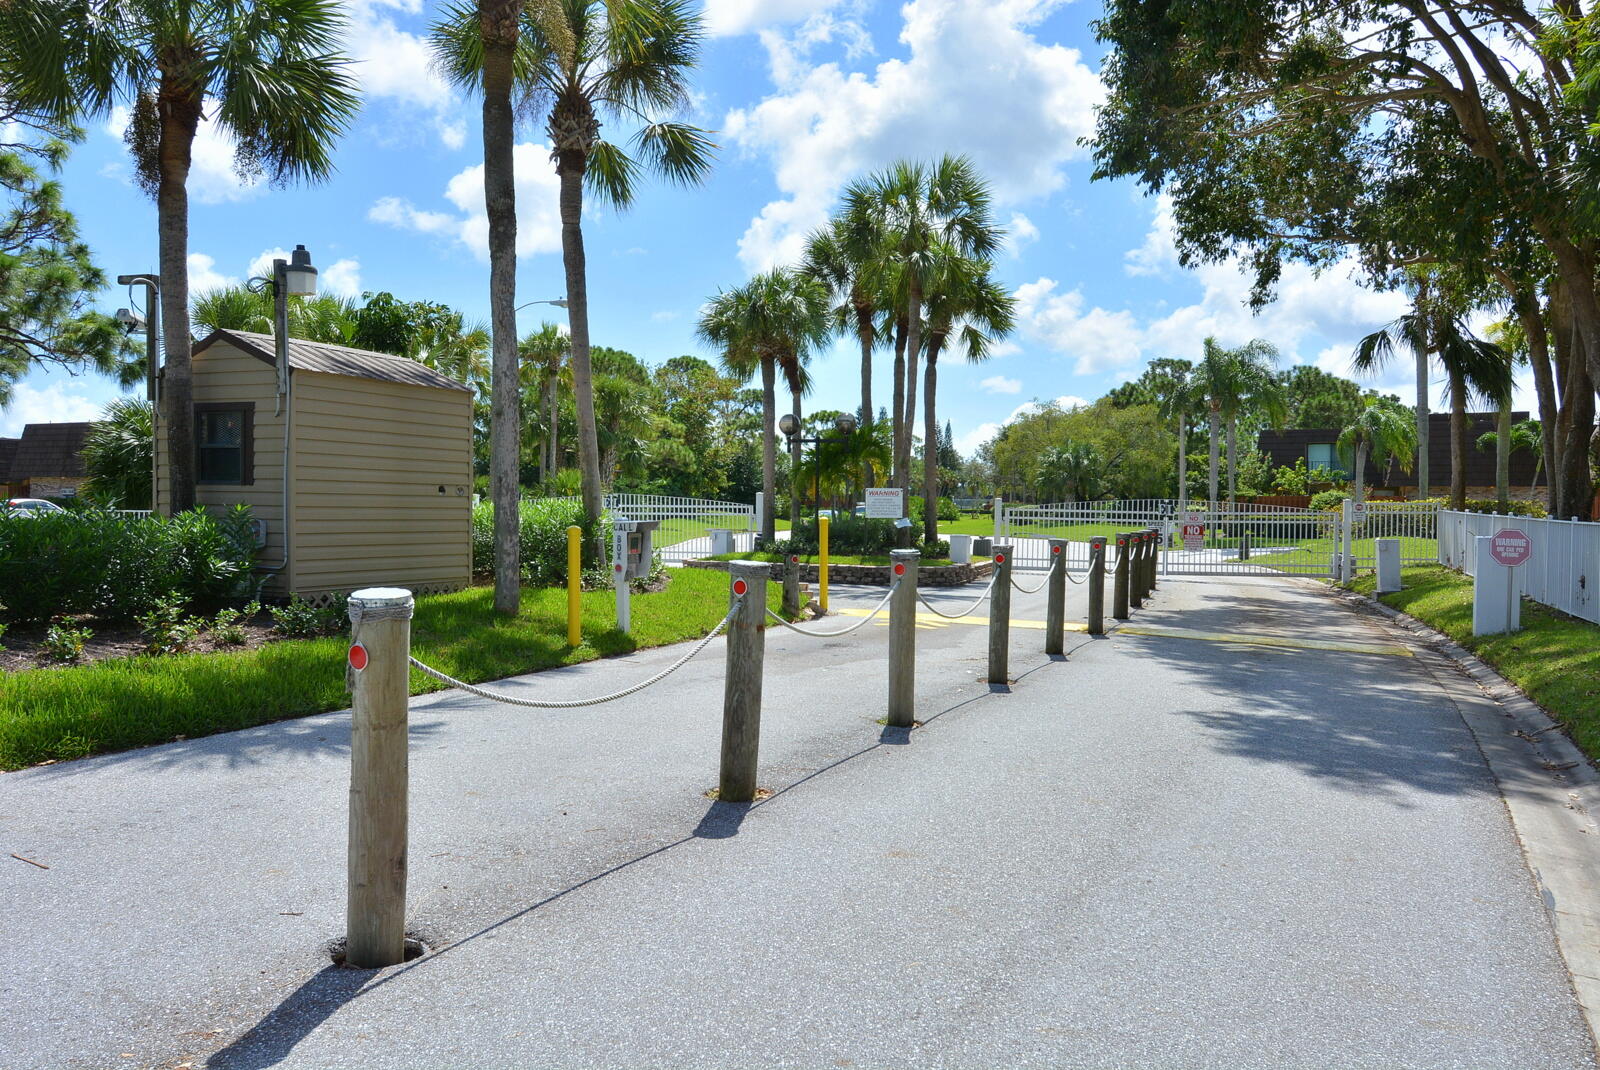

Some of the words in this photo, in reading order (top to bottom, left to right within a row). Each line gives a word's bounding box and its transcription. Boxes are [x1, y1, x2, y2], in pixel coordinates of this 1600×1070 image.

[613, 522, 633, 531] CALL
[1186, 526, 1200, 535] NO
[1495, 538, 1527, 546] WARNING
